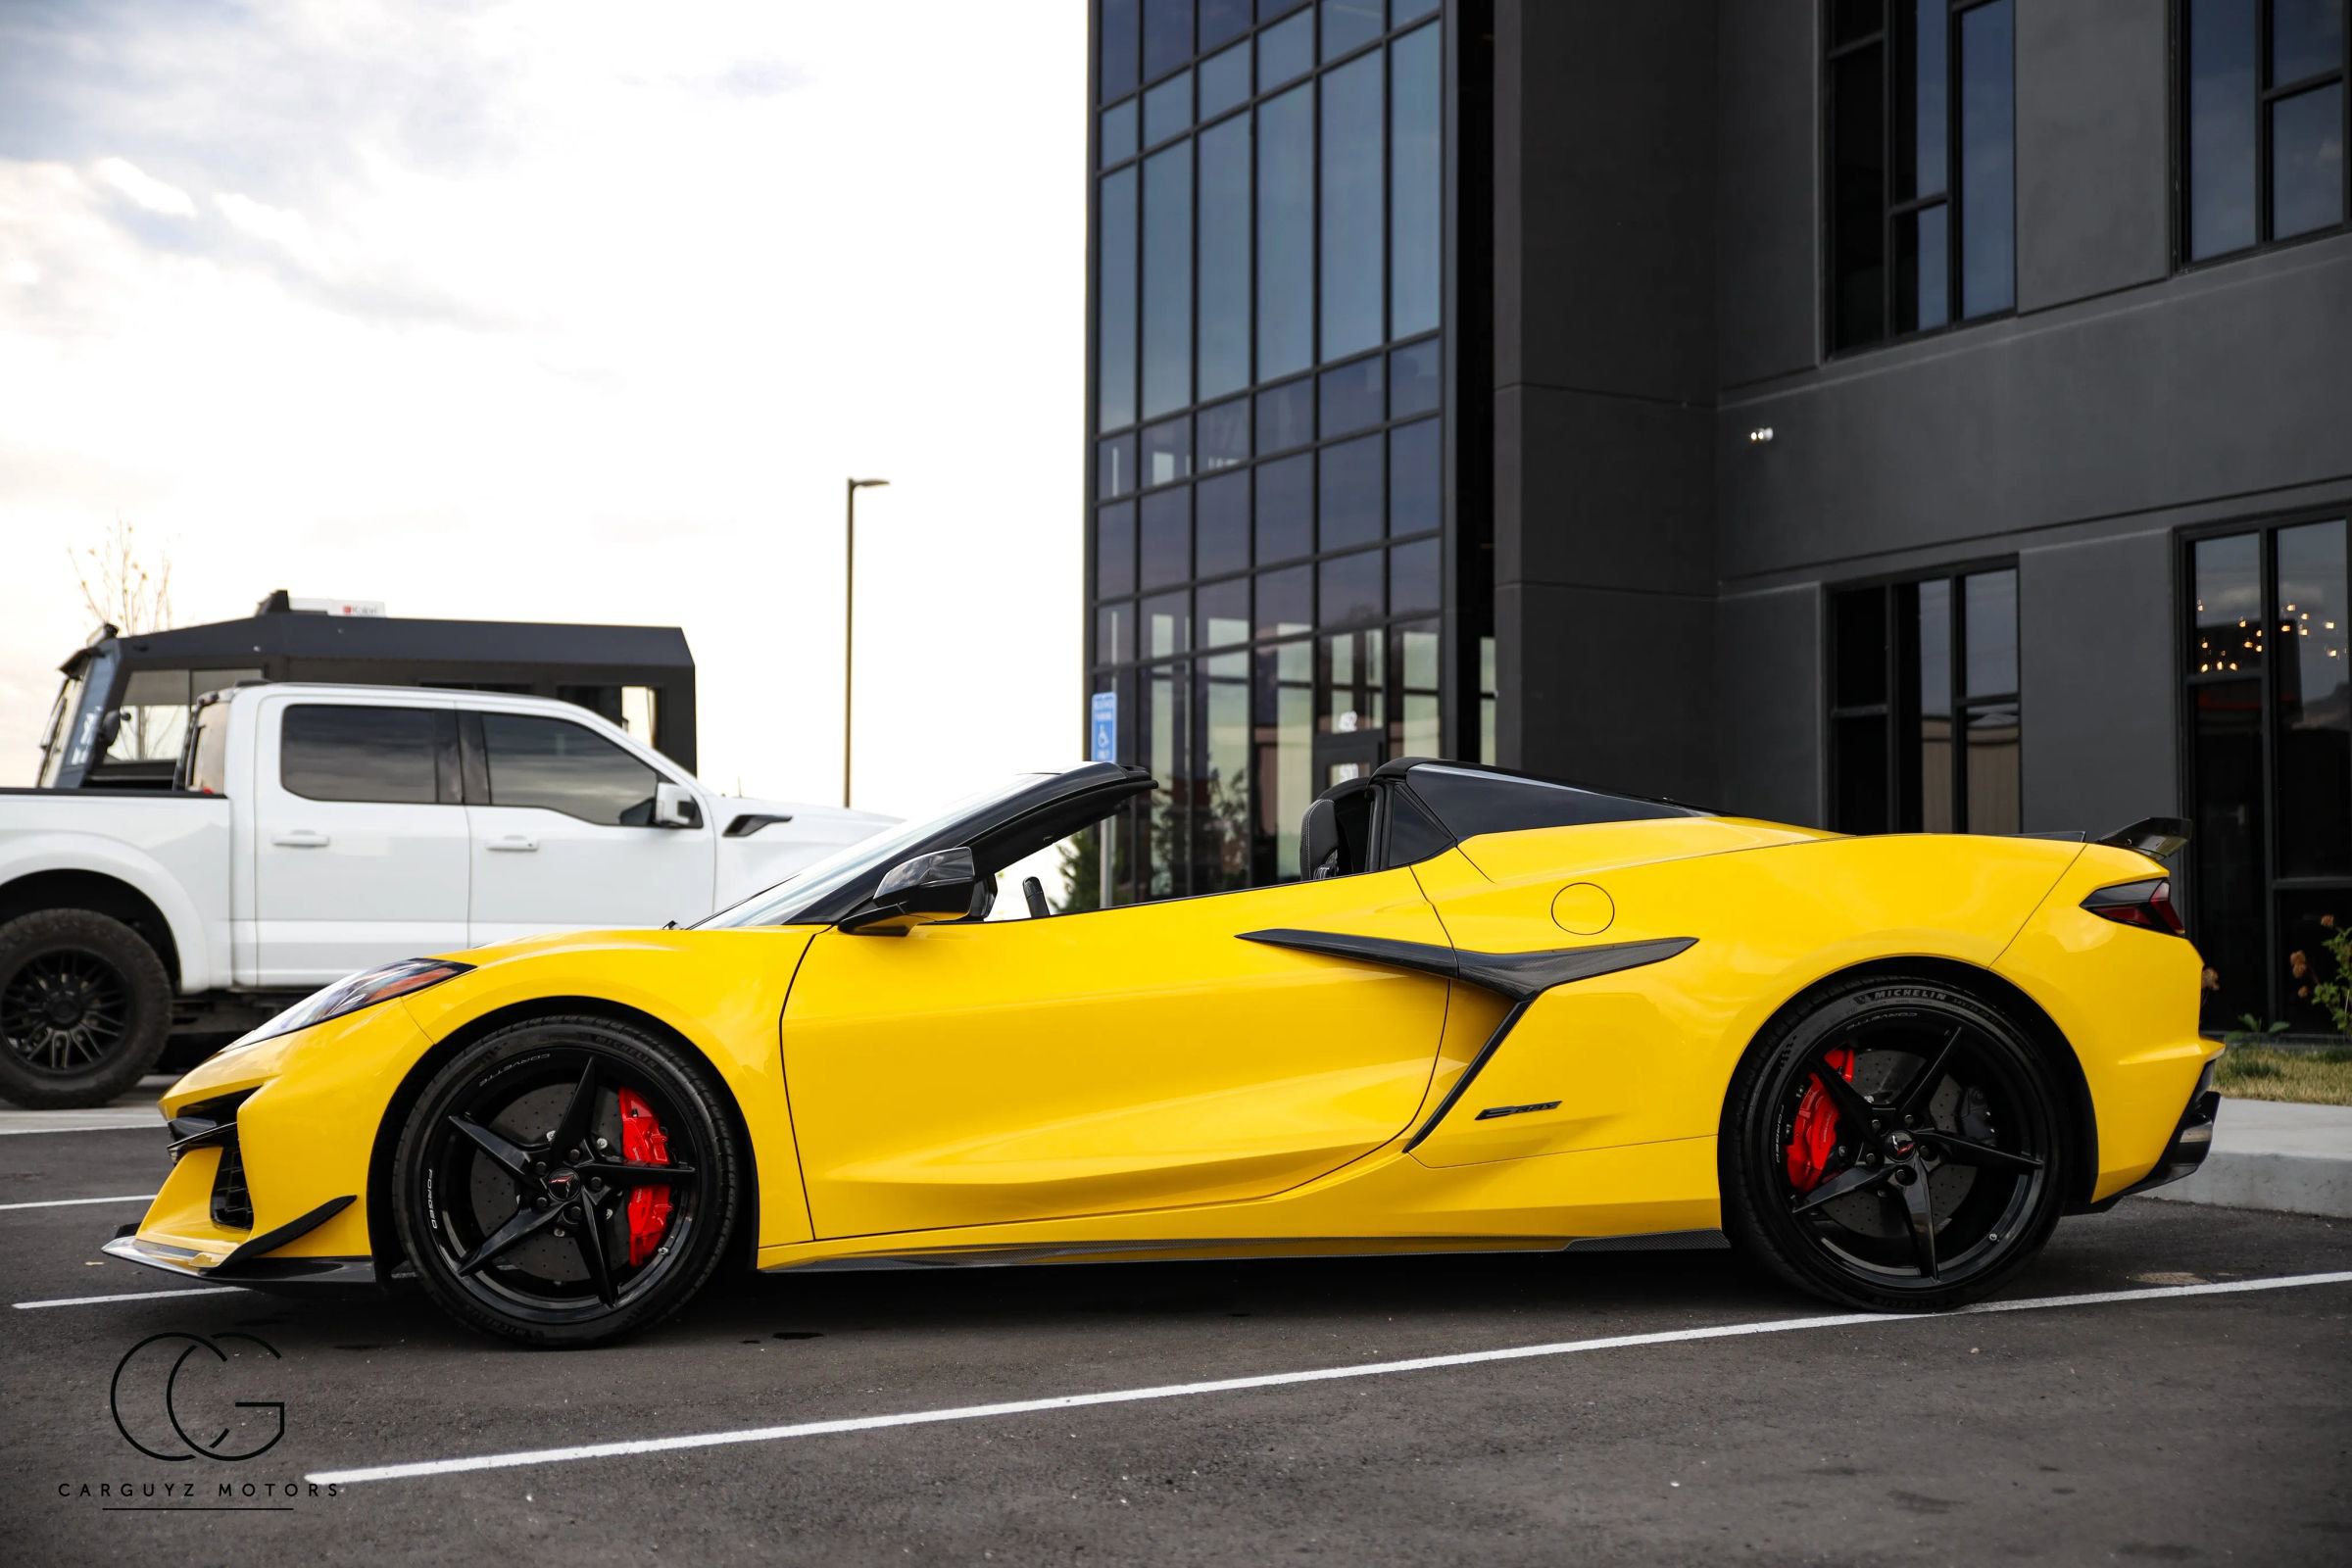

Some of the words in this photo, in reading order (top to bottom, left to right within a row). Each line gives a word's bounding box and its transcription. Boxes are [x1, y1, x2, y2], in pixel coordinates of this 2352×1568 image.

[1874, 988, 1947, 1001] MICHELIN
[595, 1035, 658, 1068] MICHELIN
[479, 1053, 551, 1087] CORVETTE
[426, 1168, 438, 1230] FORGED
